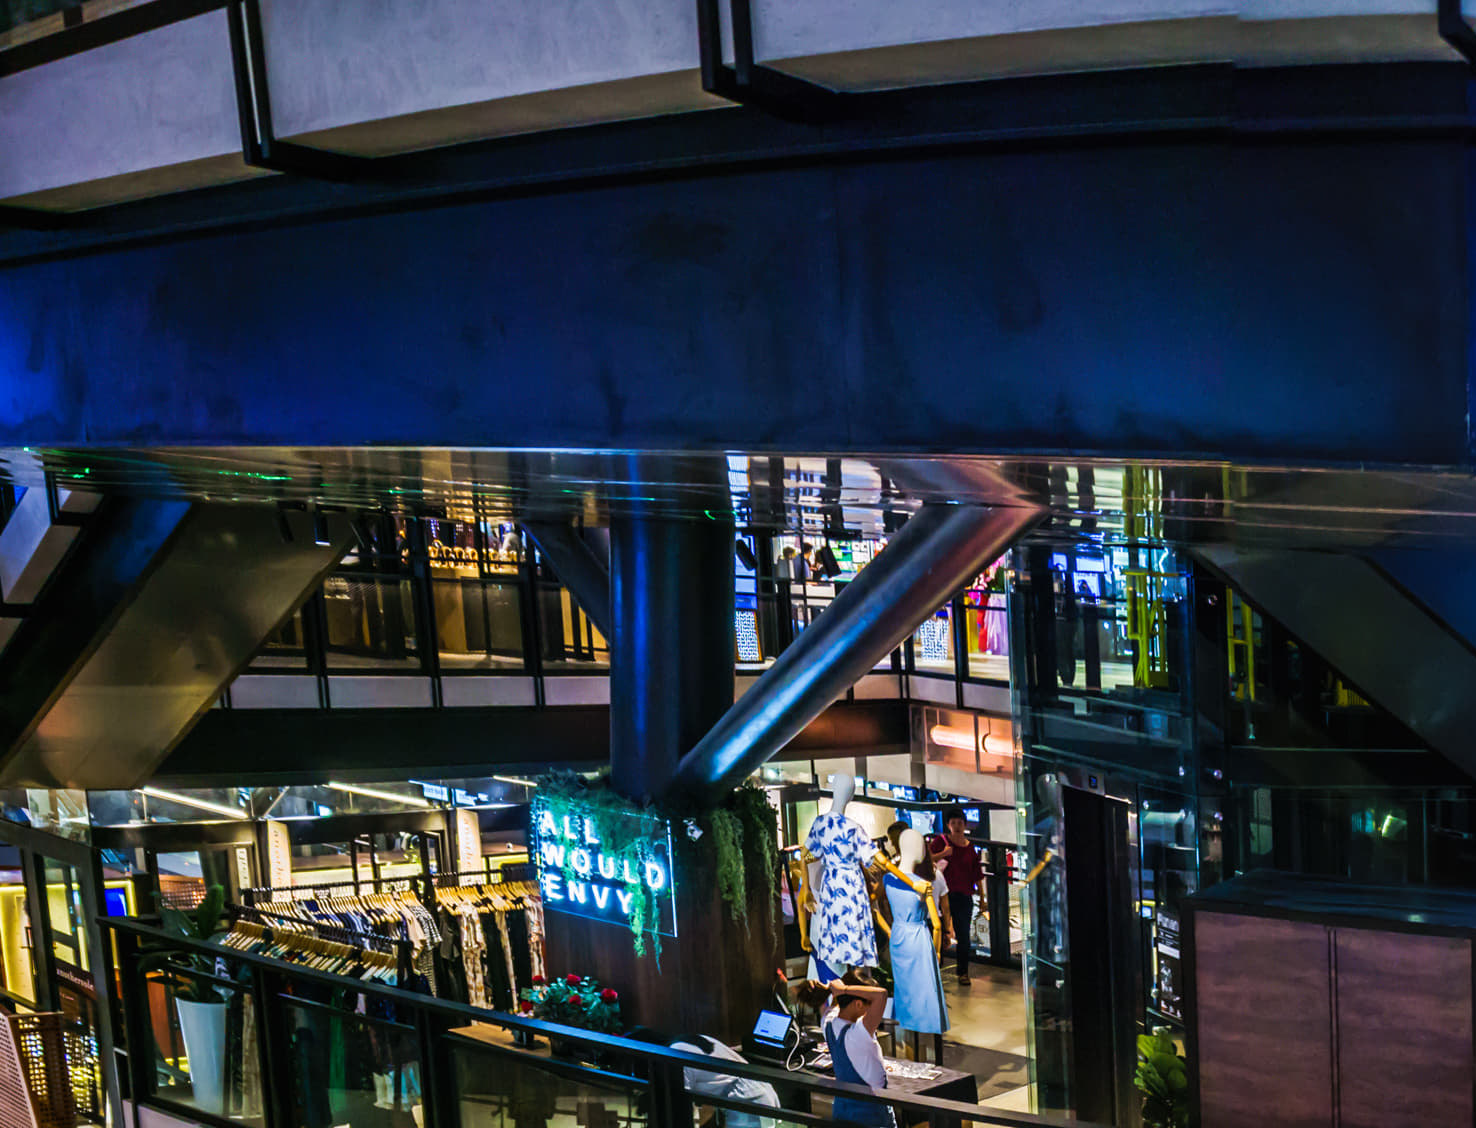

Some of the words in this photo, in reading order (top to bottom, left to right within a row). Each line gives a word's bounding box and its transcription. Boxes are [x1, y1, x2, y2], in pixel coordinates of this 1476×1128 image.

[538, 811, 600, 844] ALL
[541, 842, 664, 889] WOULD
[544, 873, 634, 914] ENVY
